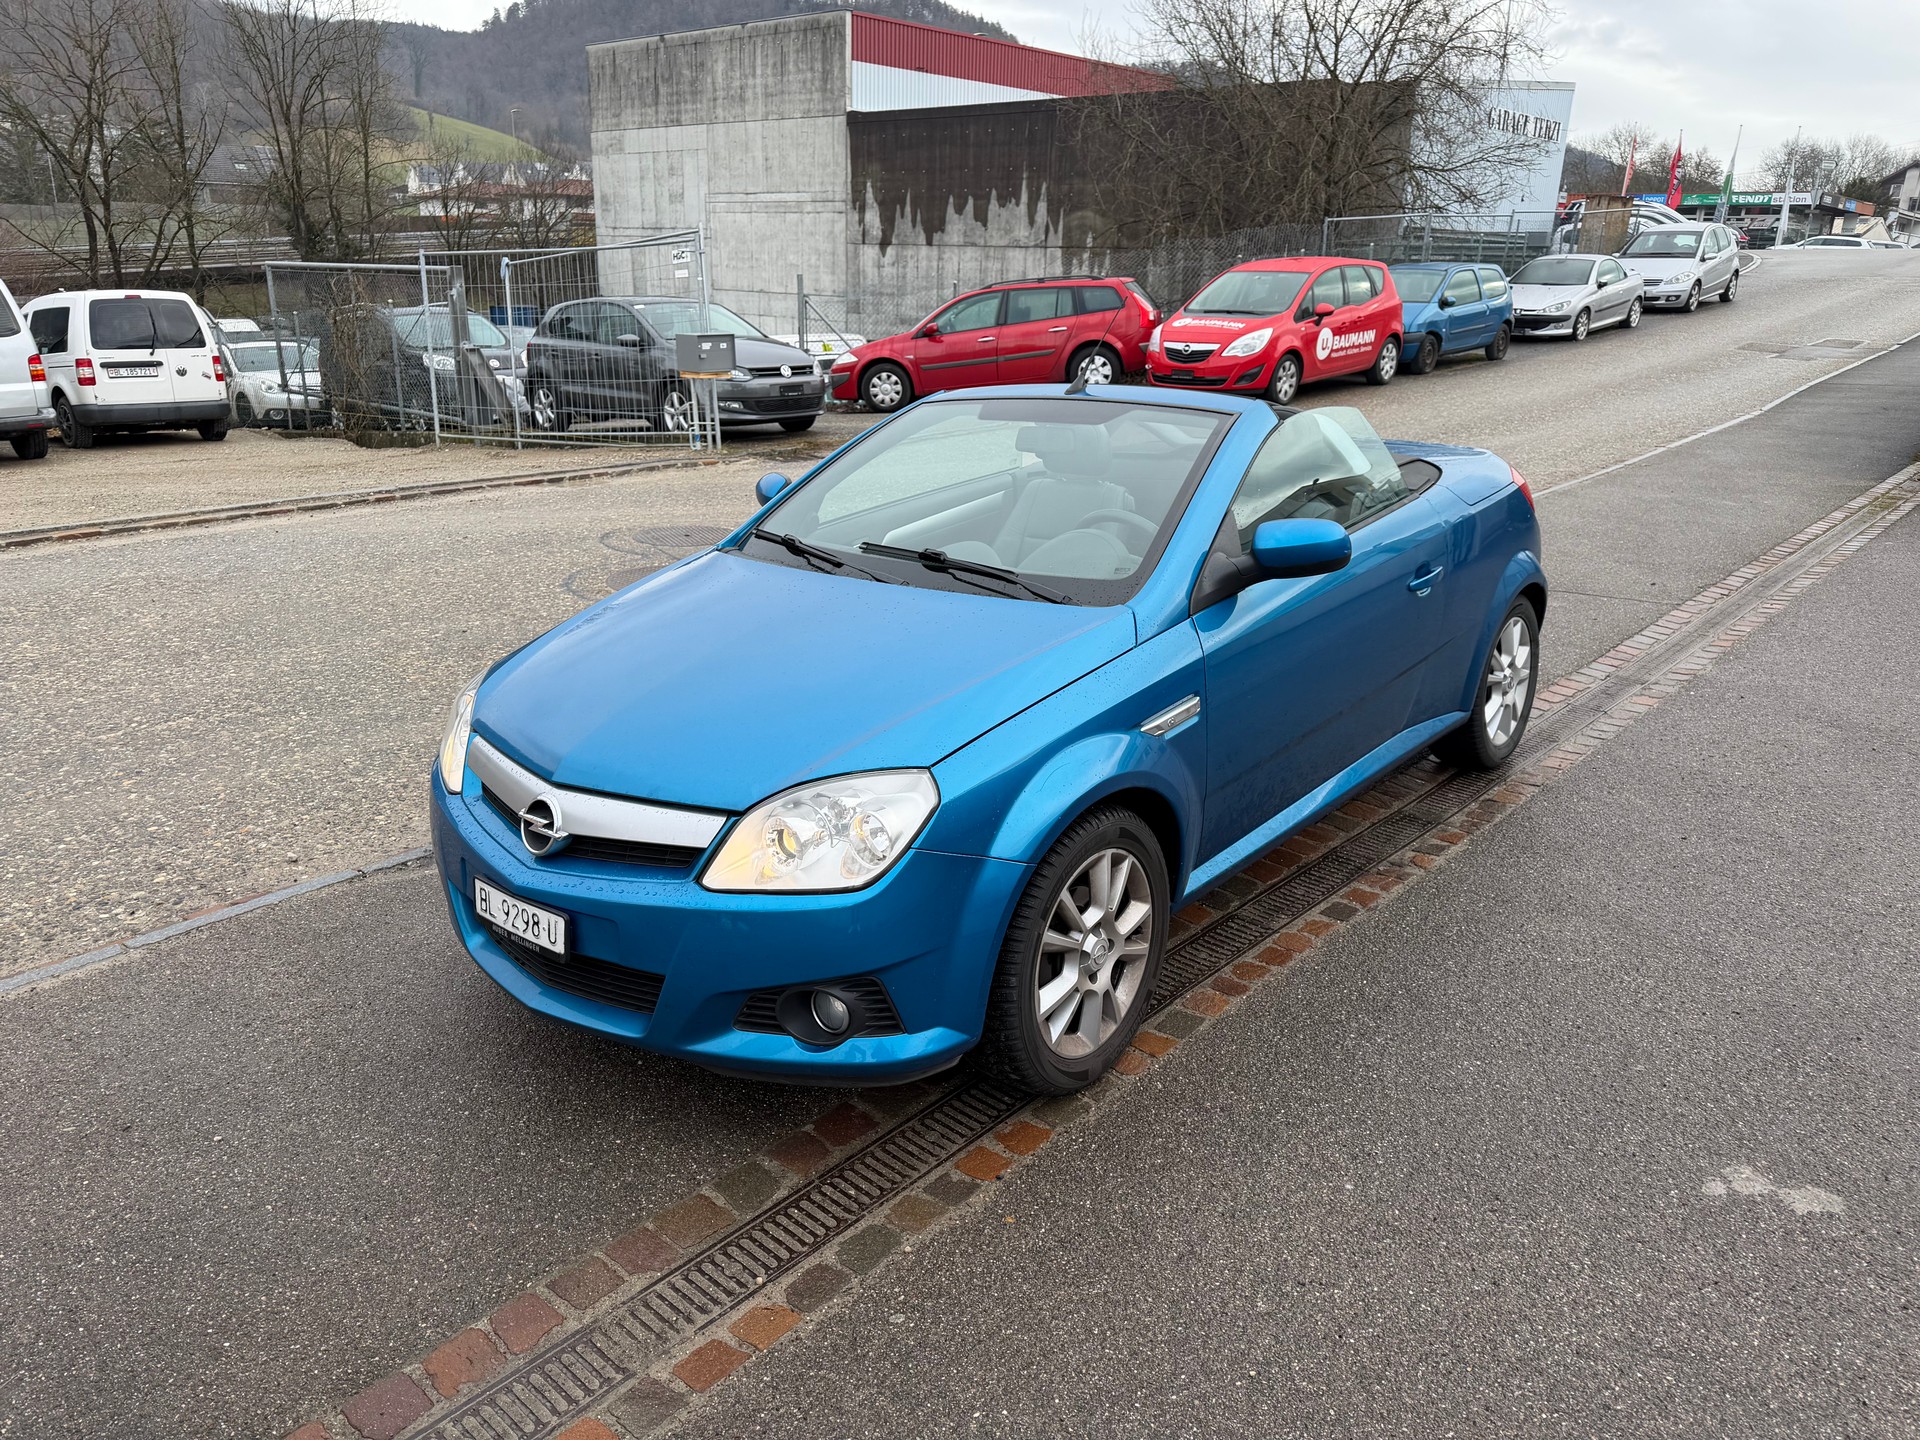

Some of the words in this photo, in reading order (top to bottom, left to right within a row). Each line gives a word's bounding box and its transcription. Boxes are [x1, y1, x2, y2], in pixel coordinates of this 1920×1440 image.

[1488, 107, 1529, 136] GARAGE
[1533, 117, 1561, 141] TERZI
[1731, 194, 1772, 203] FENDT
[1772, 195, 1807, 203] sttion
[1333, 329, 1377, 350] BAUMANN
